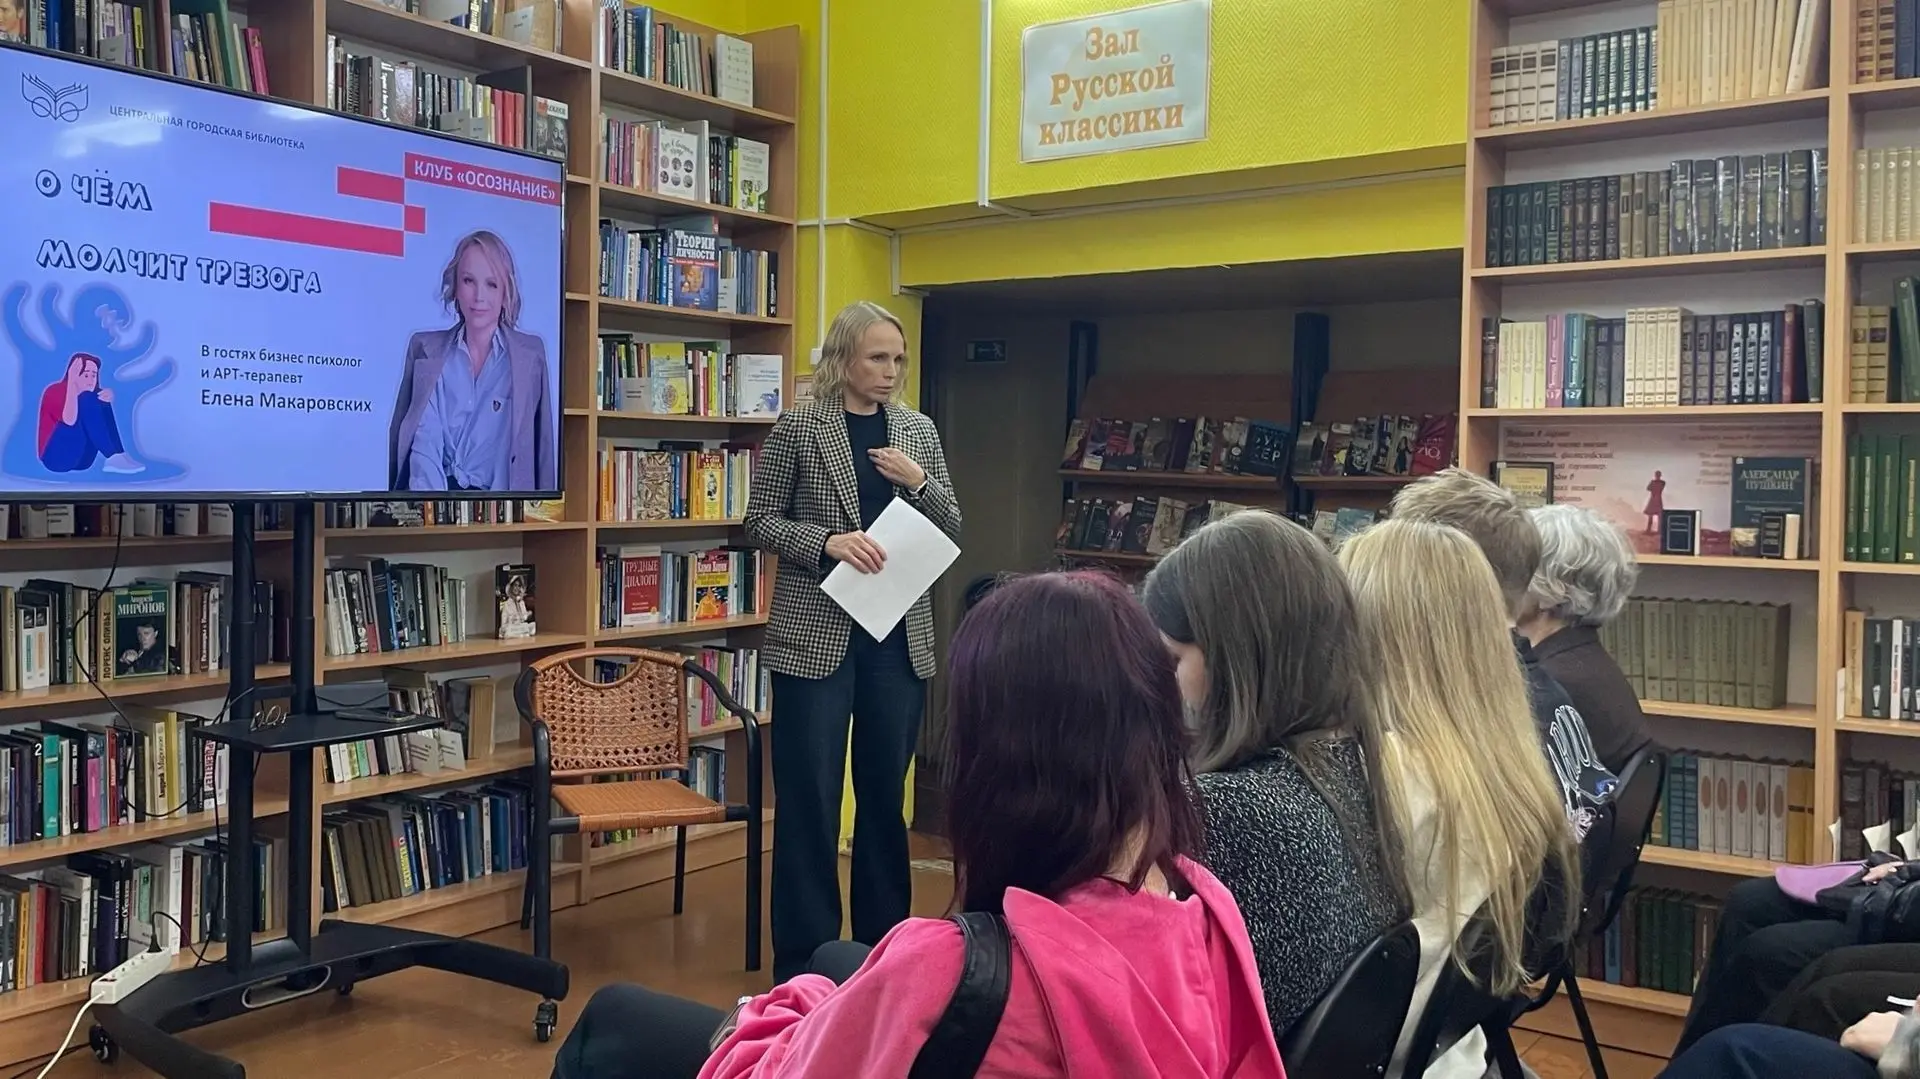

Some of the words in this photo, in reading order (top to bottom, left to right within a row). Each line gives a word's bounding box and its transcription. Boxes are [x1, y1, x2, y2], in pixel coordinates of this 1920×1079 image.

[1085, 27, 1139, 61] Зал
[1049, 54, 1175, 111] Русской
[109, 104, 183, 128] ЦЕНТРАЛЬНАЯ
[186, 120, 244, 140] ГОРОДСКАЯ
[245, 130, 305, 150] БИБЛИОТЕКА
[1038, 103, 1184, 145] классики
[35, 169, 61, 197] О
[71, 169, 153, 211] ЧЁМ
[414, 160, 453, 183] КЛУБ
[456, 169, 556, 201] «ОСОЗНАНИЕ»
[676, 232, 715, 250] ТЕОРИИ
[676, 248, 715, 260] ЛИЧНОСТИ
[36, 239, 187, 282] МОЛЧИТ
[197, 257, 321, 295] ТРЕВОГА
[201, 345, 210, 358] В
[213, 348, 256, 363] гостях
[259, 347, 304, 364] бизнес
[307, 353, 363, 370] психолог
[201, 369, 209, 379] и
[213, 367, 303, 386] АРТ-терапевт
[201, 388, 254, 408] Елена
[260, 391, 372, 413] Макаровских
[1740, 469, 1800, 480] АЛЕКСАНДР
[1745, 479, 1794, 490] ПУШКИН
[626, 559, 659, 573] ТРУДНЫЕ
[625, 574, 658, 588] ДИАЛОГИ
[118, 602, 165, 615] МИРОНОВ
[102, 611, 111, 644] ОЛИВЬЕ
[103, 645, 112, 679] ЛОРЕНС
